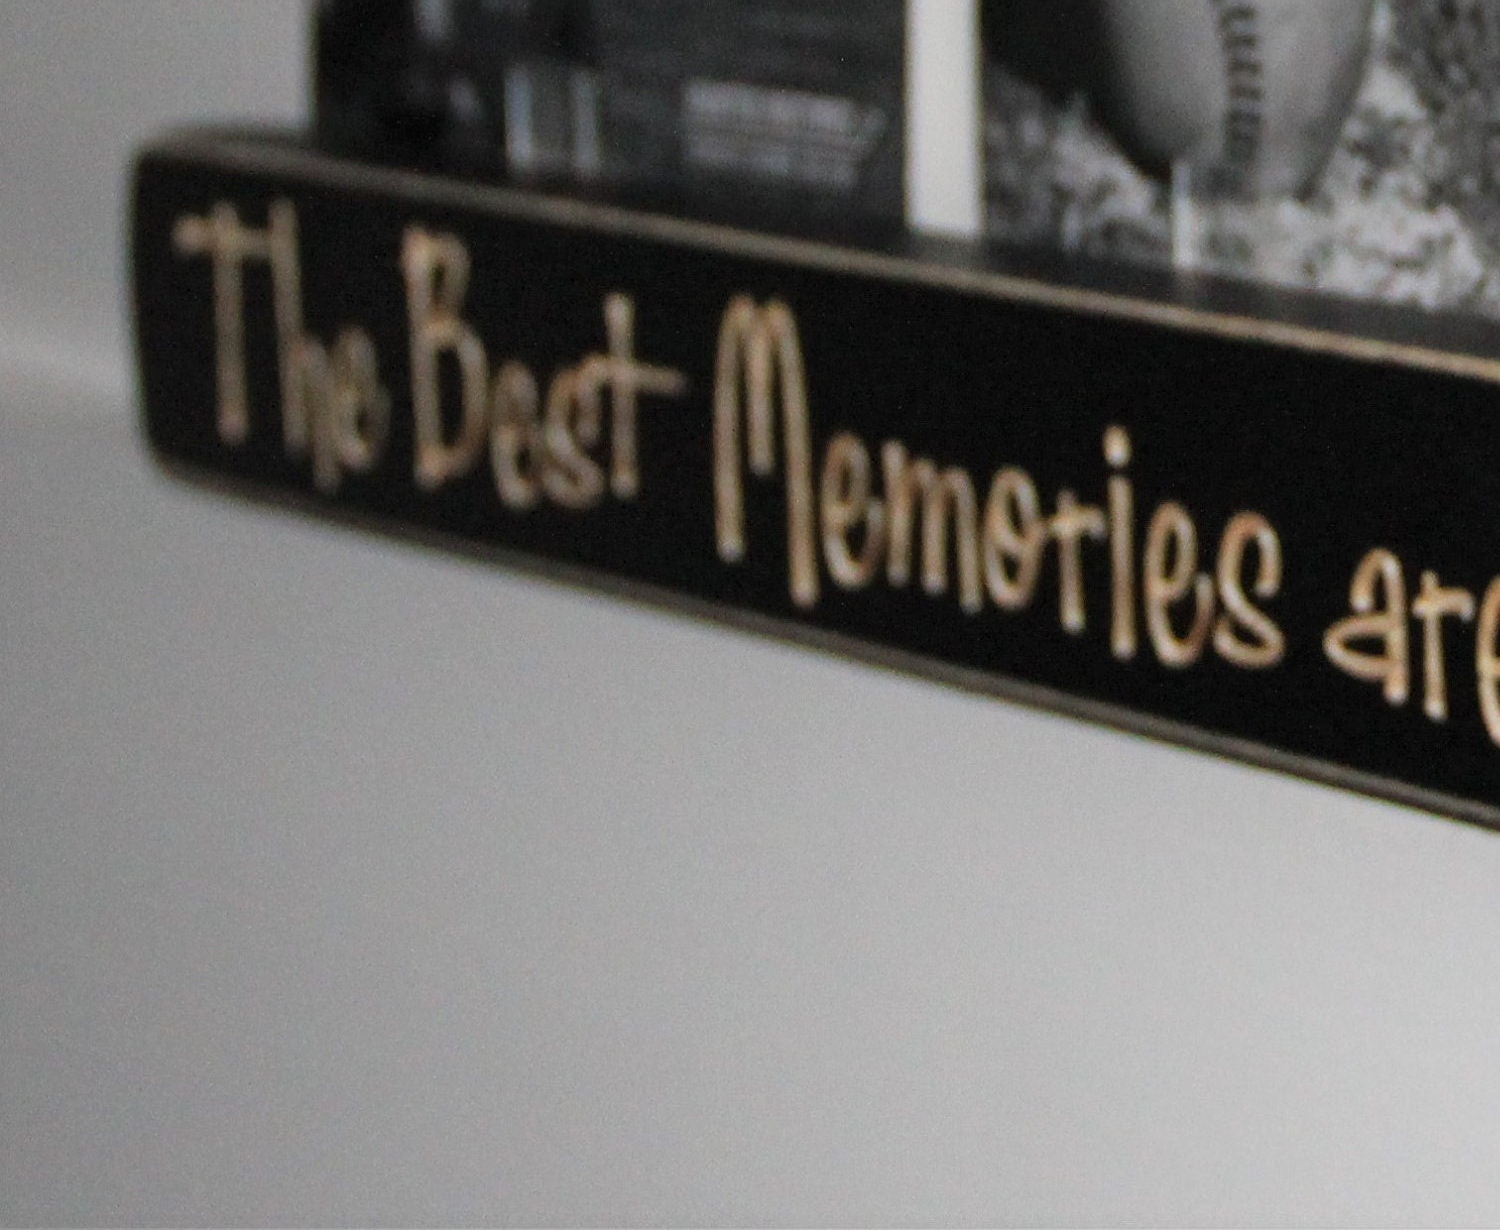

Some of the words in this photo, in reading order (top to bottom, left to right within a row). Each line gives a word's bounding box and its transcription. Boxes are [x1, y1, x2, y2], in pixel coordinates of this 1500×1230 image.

[172, 199, 391, 492] The
[402, 225, 686, 508] Best
[713, 295, 1286, 669] Memories
